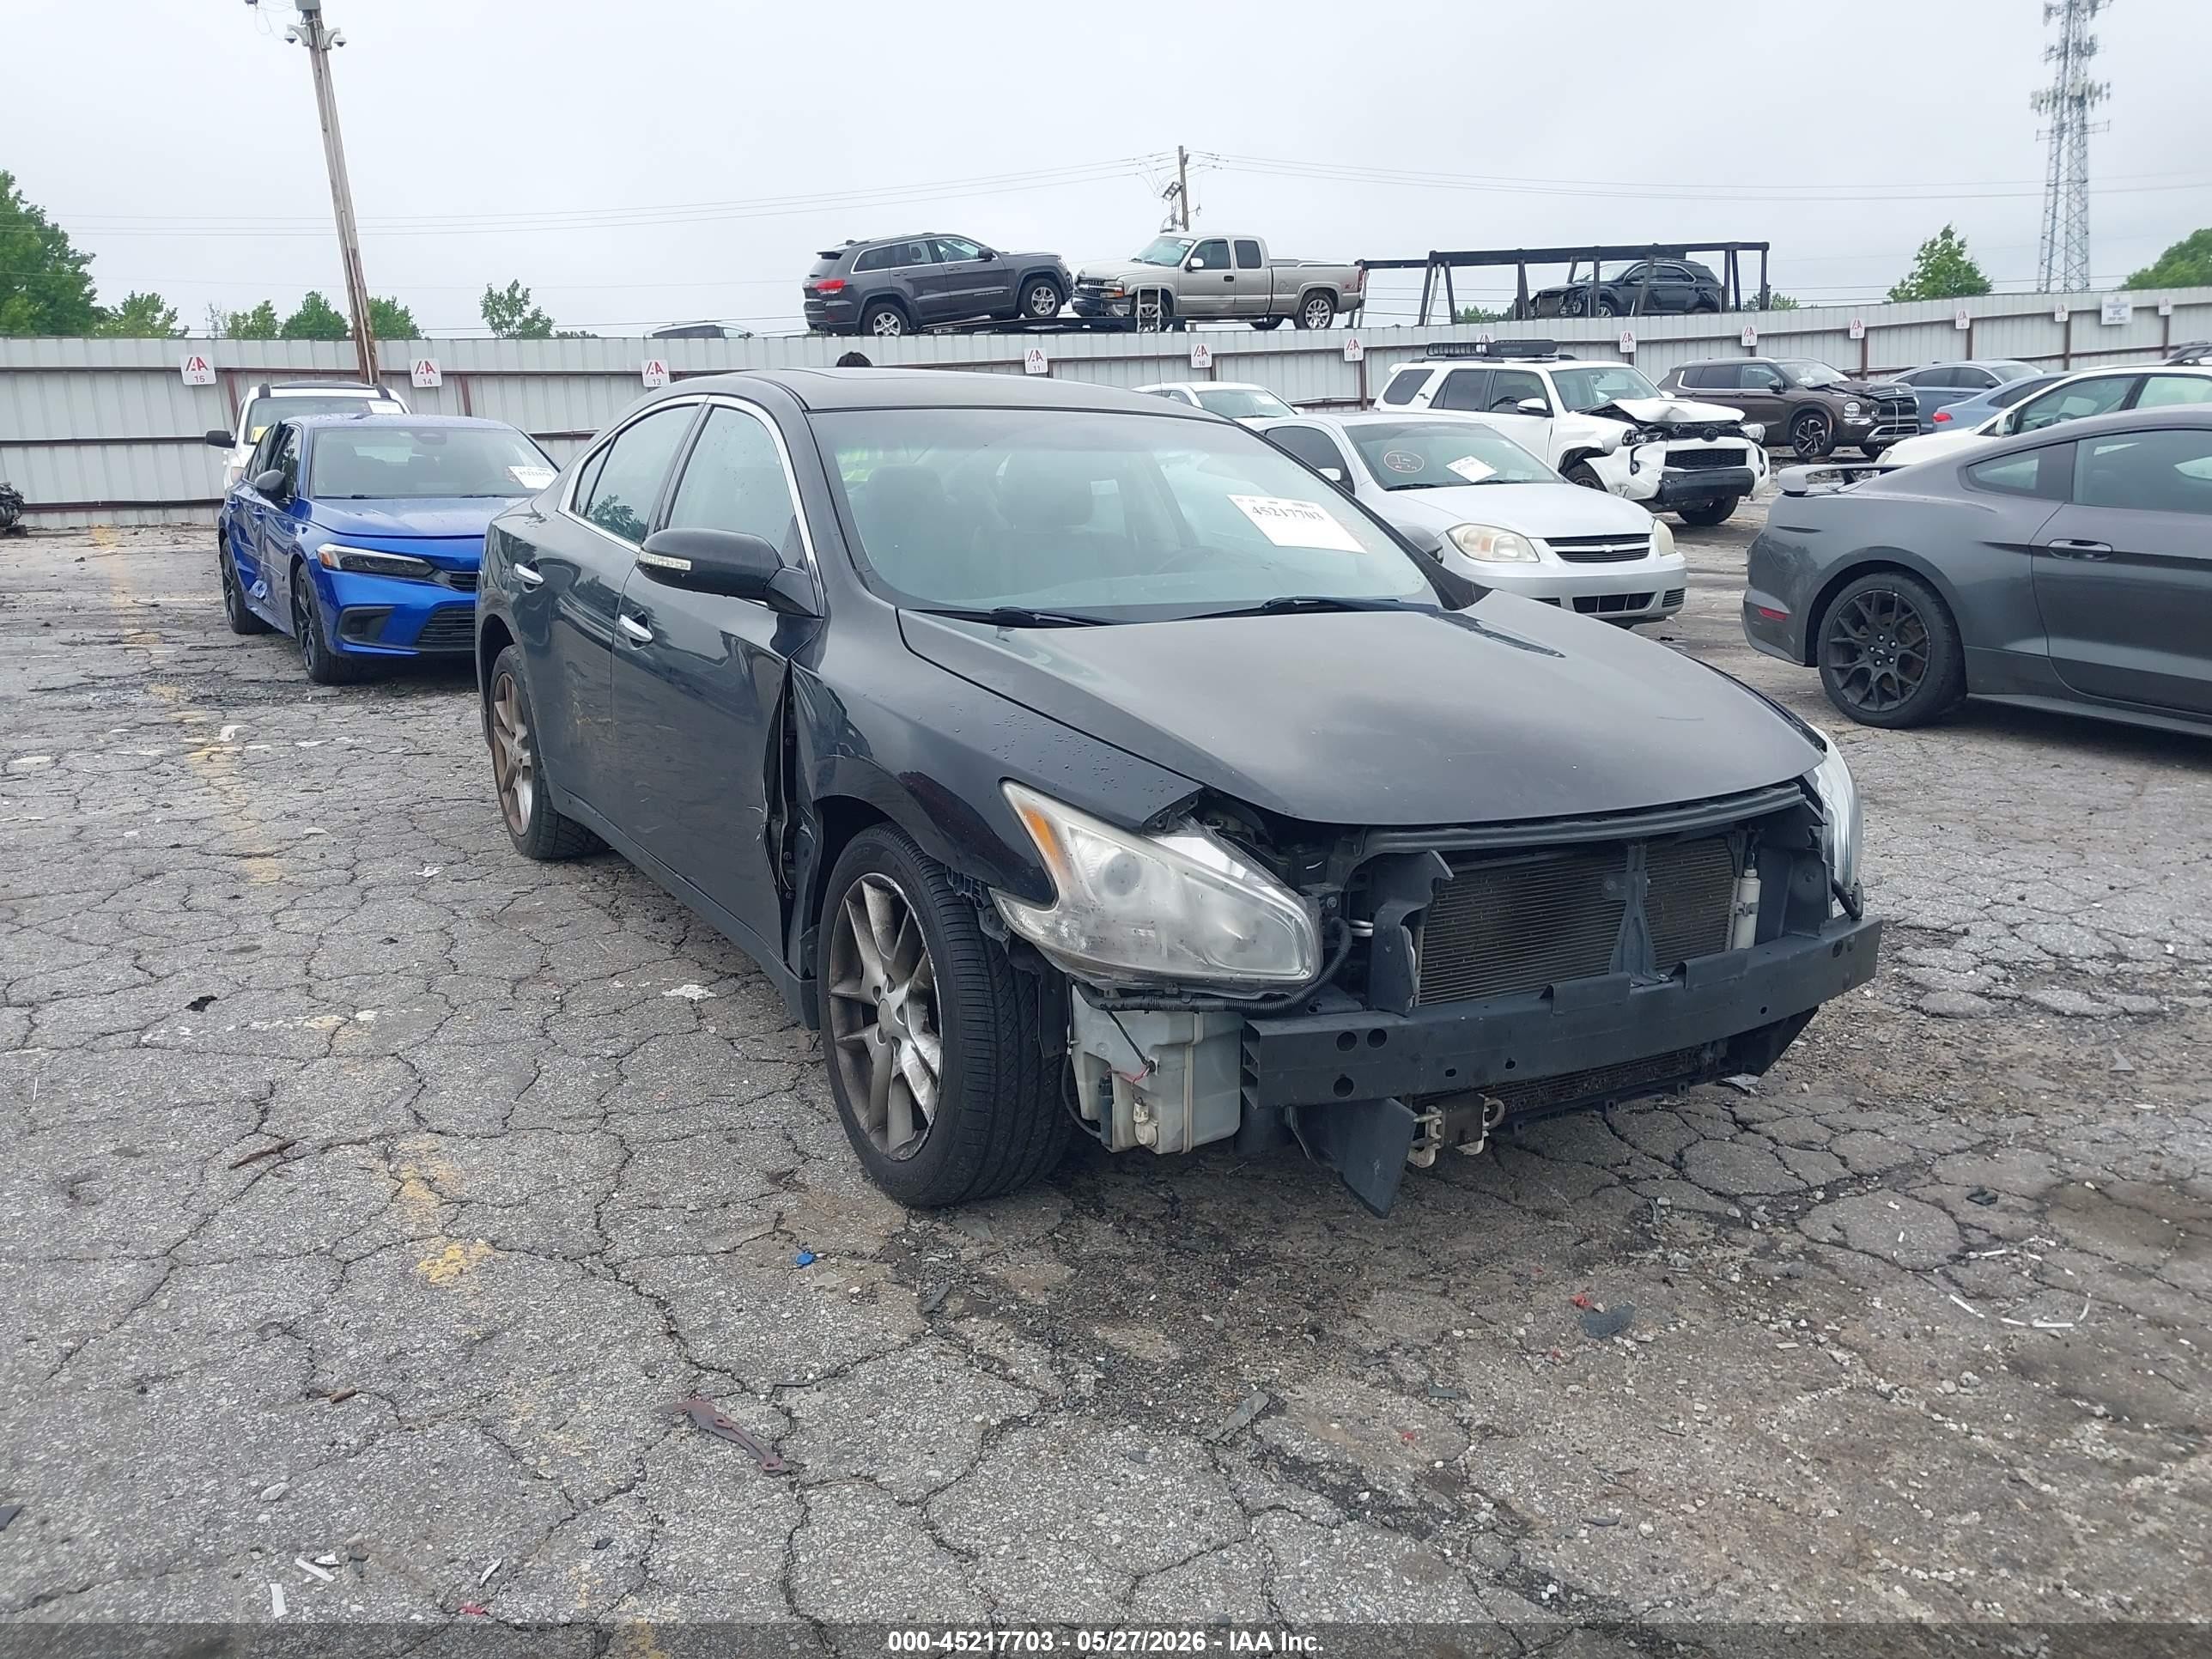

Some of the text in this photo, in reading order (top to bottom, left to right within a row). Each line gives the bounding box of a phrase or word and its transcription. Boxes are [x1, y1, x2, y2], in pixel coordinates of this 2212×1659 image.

[1027, 349, 1044, 362] IAA
[185, 356, 209, 372] IAA
[414, 361, 436, 374] IAA
[645, 361, 665, 375] IAA
[1252, 506, 1324, 520] 45217703
